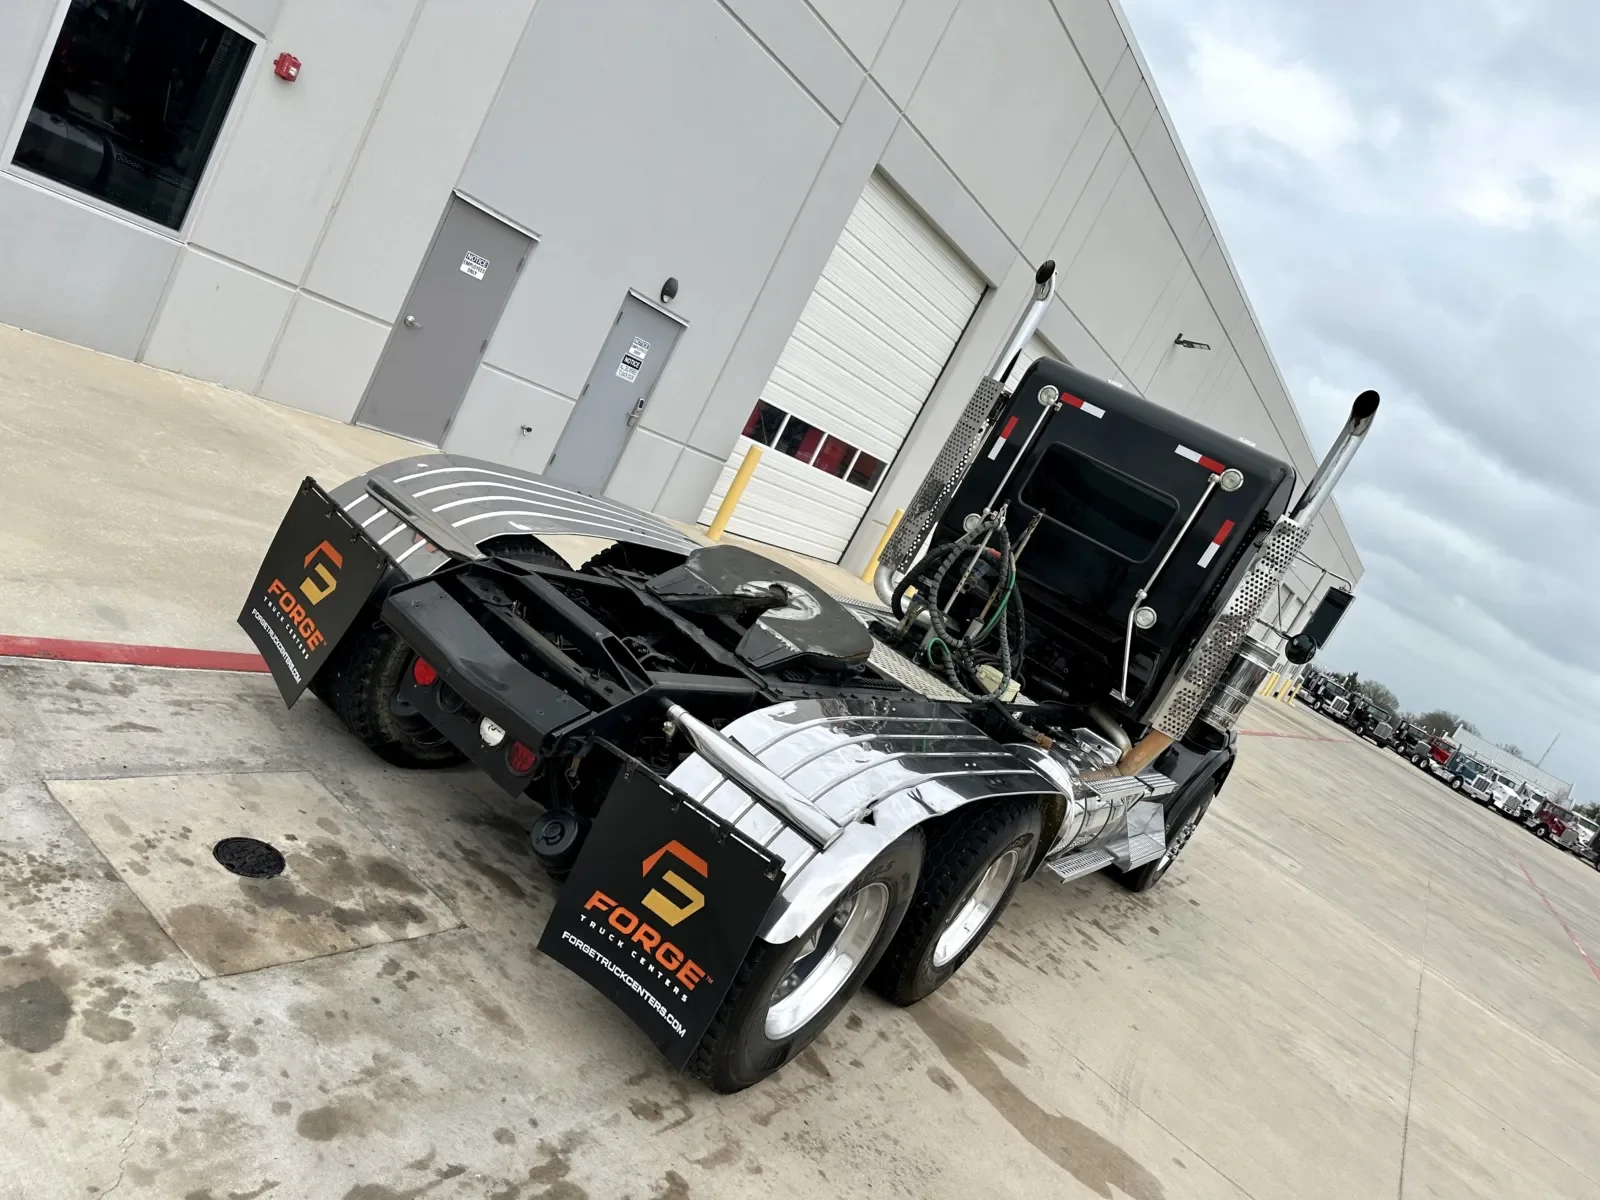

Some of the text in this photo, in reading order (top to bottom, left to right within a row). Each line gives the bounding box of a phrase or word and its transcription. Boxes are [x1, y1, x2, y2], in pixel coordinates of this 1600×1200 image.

[465, 252, 489, 269] NOTICE
[624, 356, 641, 369] NOTICE
[251, 608, 302, 684] FORGETRUCKCENTERS.COM
[263, 595, 310, 660] TRUCK CENTERS
[267, 578, 325, 652] FORGE
[580, 914, 688, 1002] TRUCK CENTERS
[584, 890, 706, 991] FORGE
[561, 930, 687, 1038] FORGETRUCKCENTERS.COM
